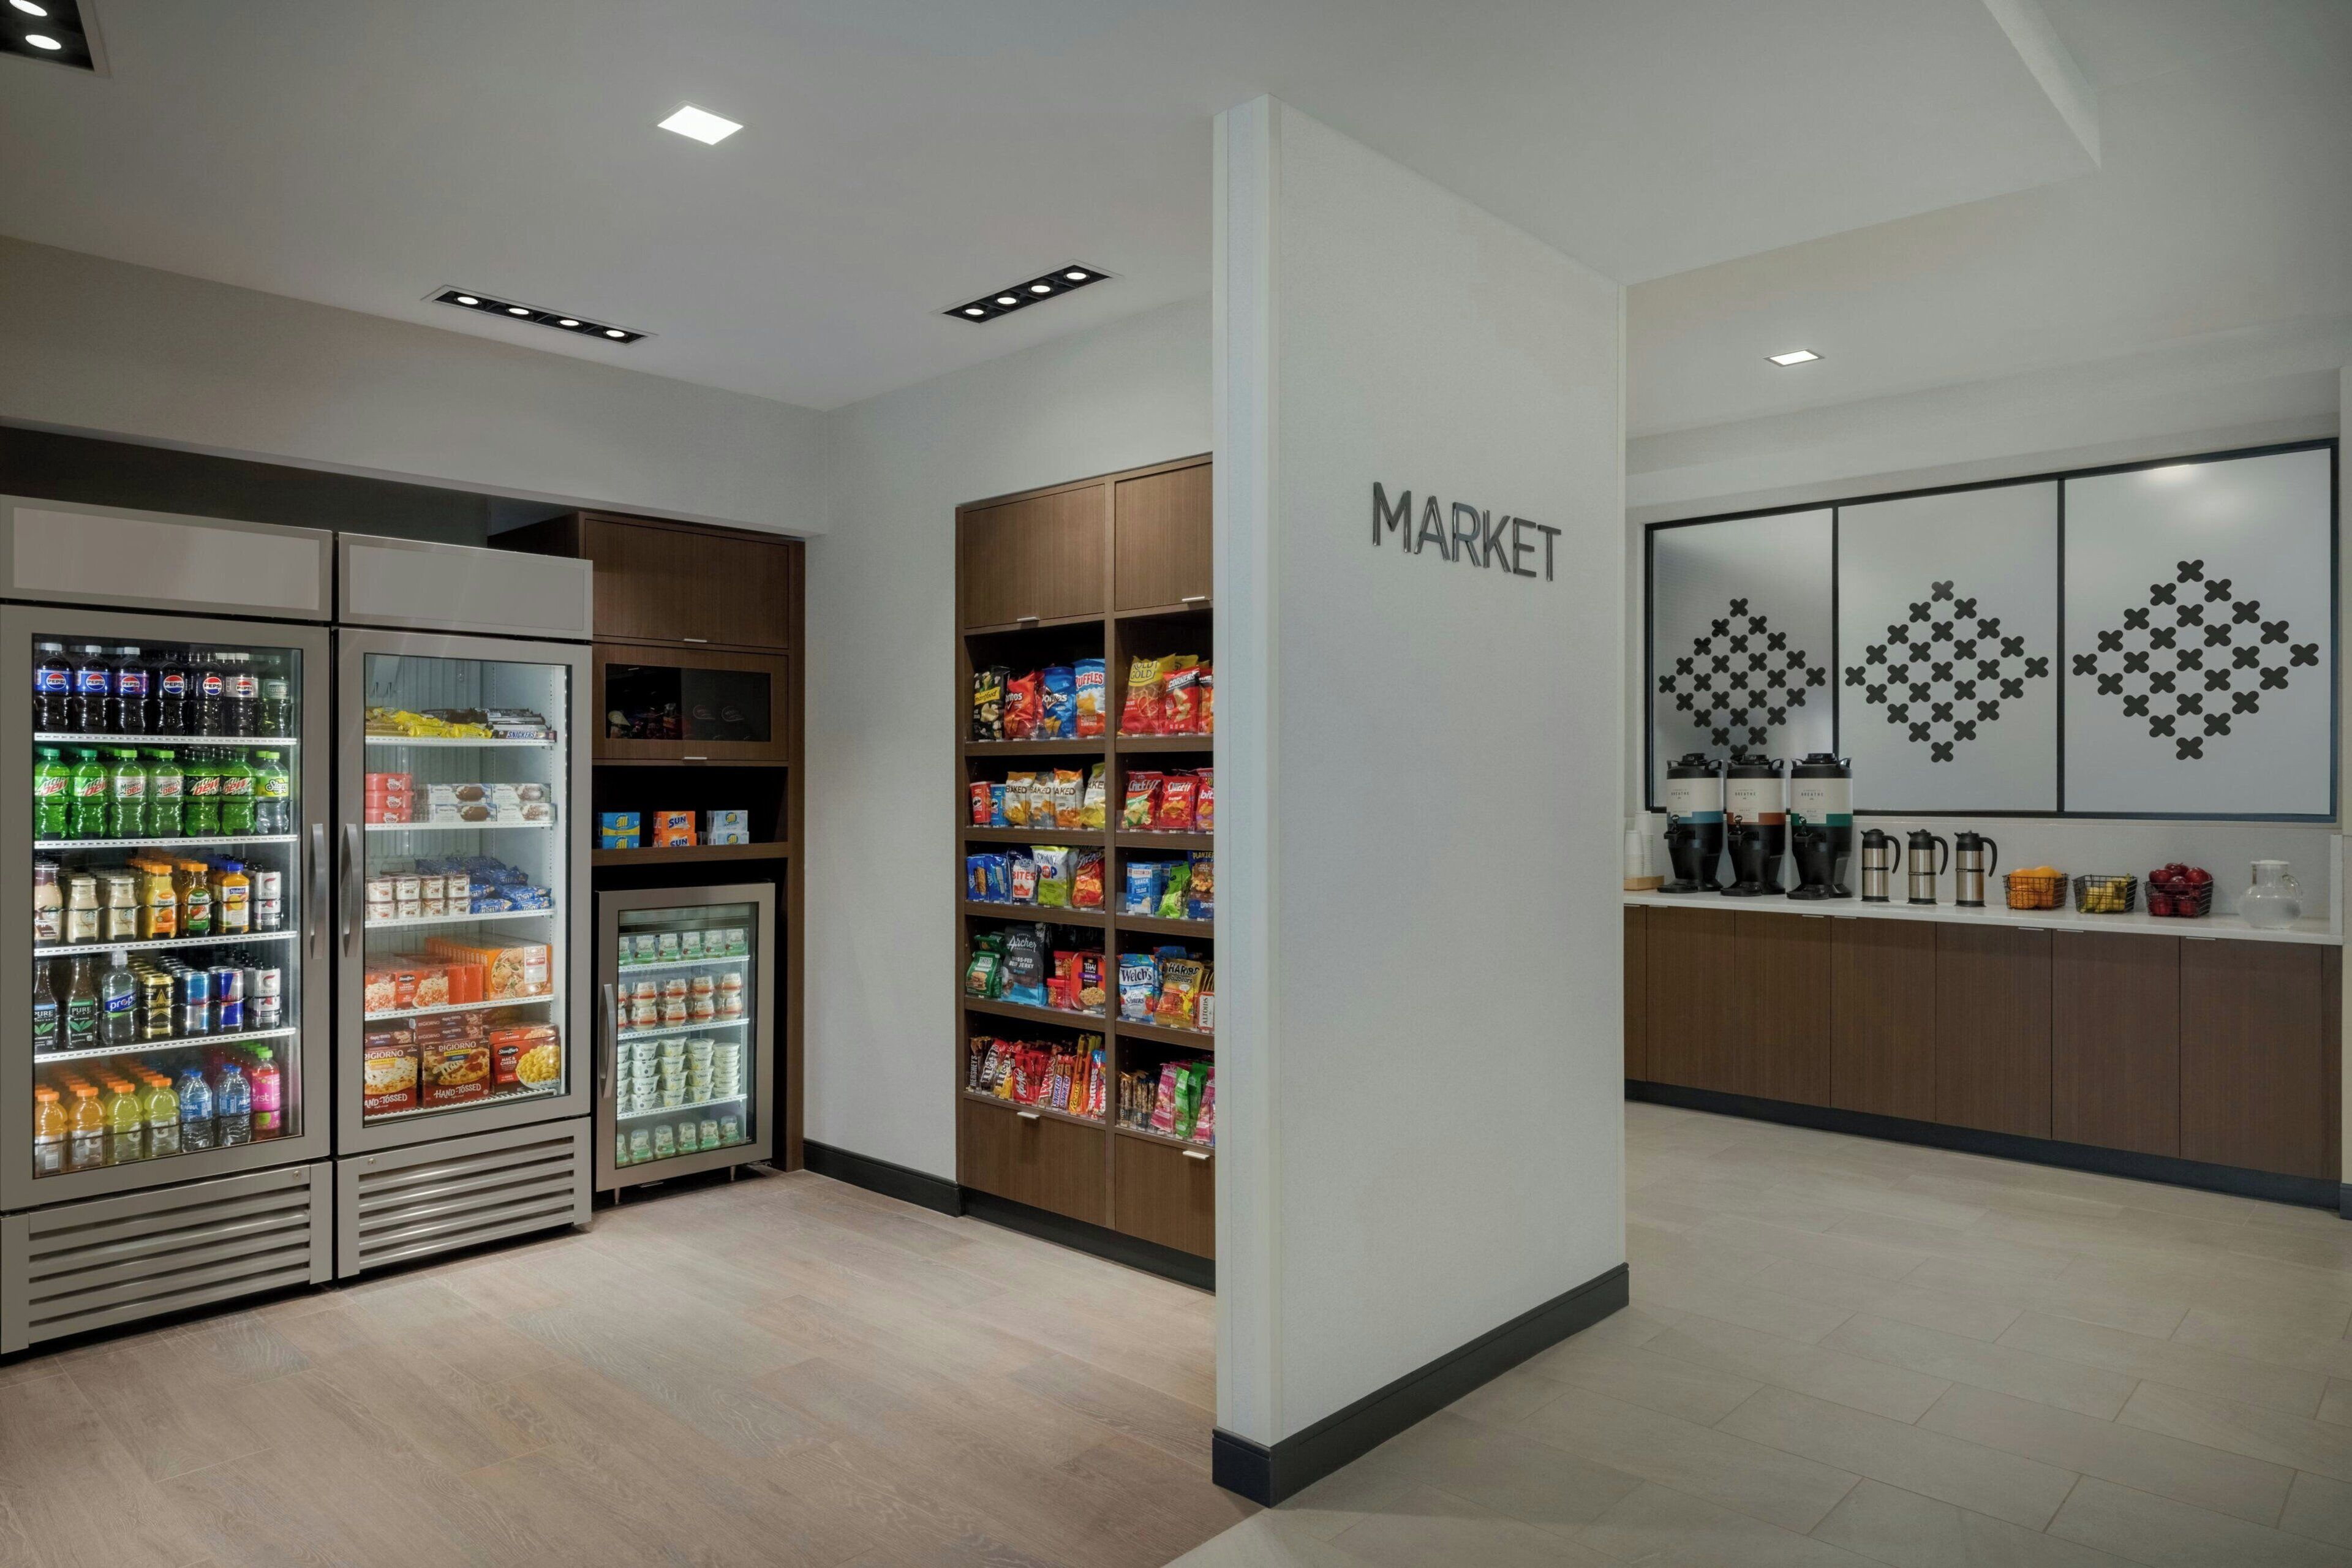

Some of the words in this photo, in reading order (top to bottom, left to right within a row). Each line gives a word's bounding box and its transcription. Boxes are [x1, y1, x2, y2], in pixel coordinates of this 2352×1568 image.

[1373, 481, 1562, 582] MARKET
[1169, 672, 1194, 688] CORNERS
[1200, 790, 1214, 799] bit
[668, 816, 686, 829] SUN
[1012, 871, 1036, 880] BITES
[1007, 935, 1036, 952] Archer
[1121, 968, 1152, 982] Welch's
[1168, 962, 1200, 976] HARIBO
[439, 1041, 477, 1052] DIGIORNO
[1038, 1057, 1055, 1101] TWIX
[434, 1084, 481, 1099] HAND-TOSSED
[1052, 1076, 1062, 1106] SNICKERS
[364, 1093, 408, 1108] AND-TOSSED
